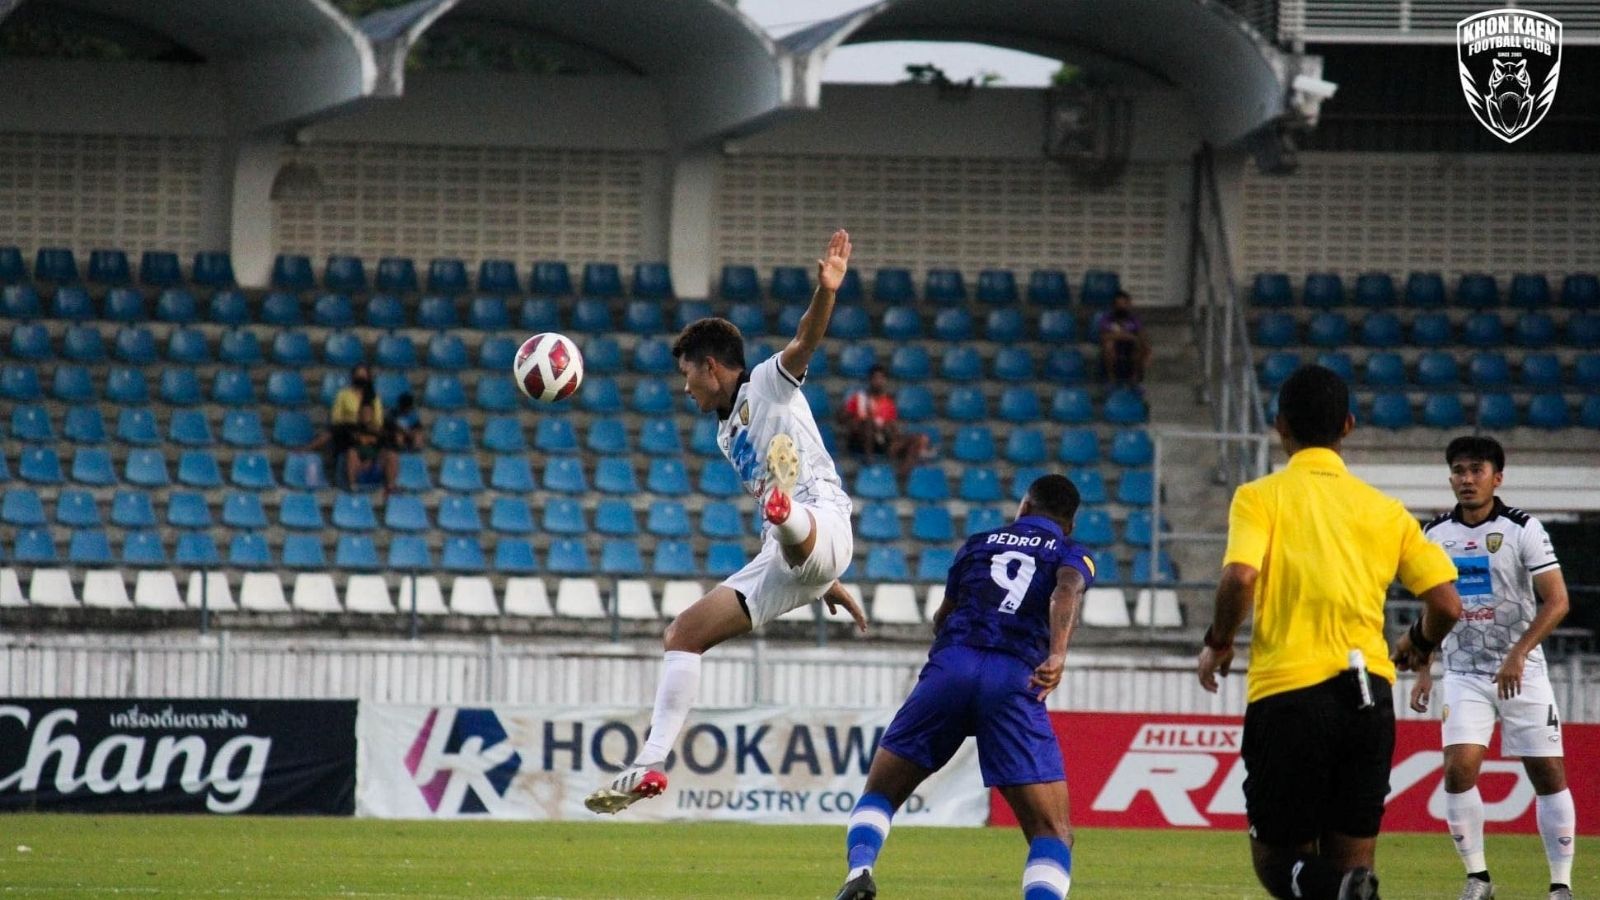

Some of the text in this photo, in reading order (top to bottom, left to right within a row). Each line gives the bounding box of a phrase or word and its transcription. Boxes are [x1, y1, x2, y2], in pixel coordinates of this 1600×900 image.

[986, 532, 1042, 547] PEDRO
[990, 550, 1037, 615] 9
[109, 703, 247, 728] เครื่องดื่มตราช้าง
[1546, 703, 1559, 732] 4
[1145, 729, 1237, 747] HILUX
[678, 788, 811, 812] INDUSTRY
